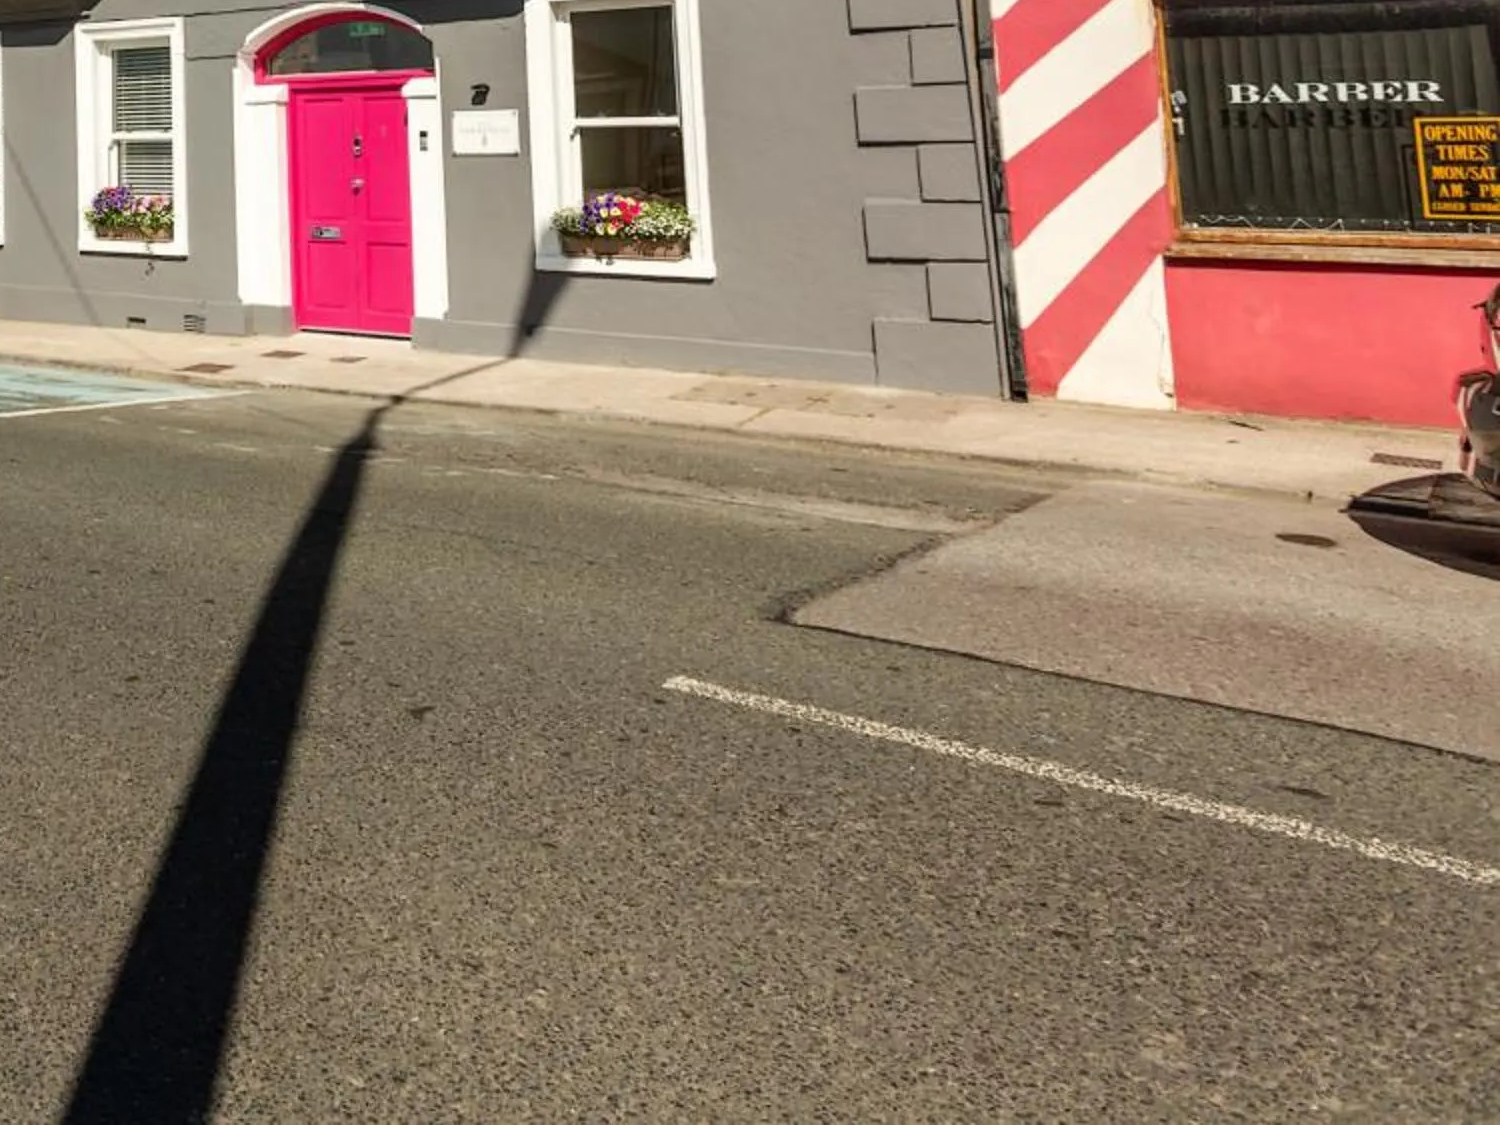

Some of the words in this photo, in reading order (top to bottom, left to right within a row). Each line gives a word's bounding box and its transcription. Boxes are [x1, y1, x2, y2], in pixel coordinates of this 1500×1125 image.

[1227, 80, 1444, 105] BARBER
[1423, 124, 1498, 143] OPENING
[1435, 143, 1491, 162] TIMES
[1430, 165, 1497, 181] MON/SAT
